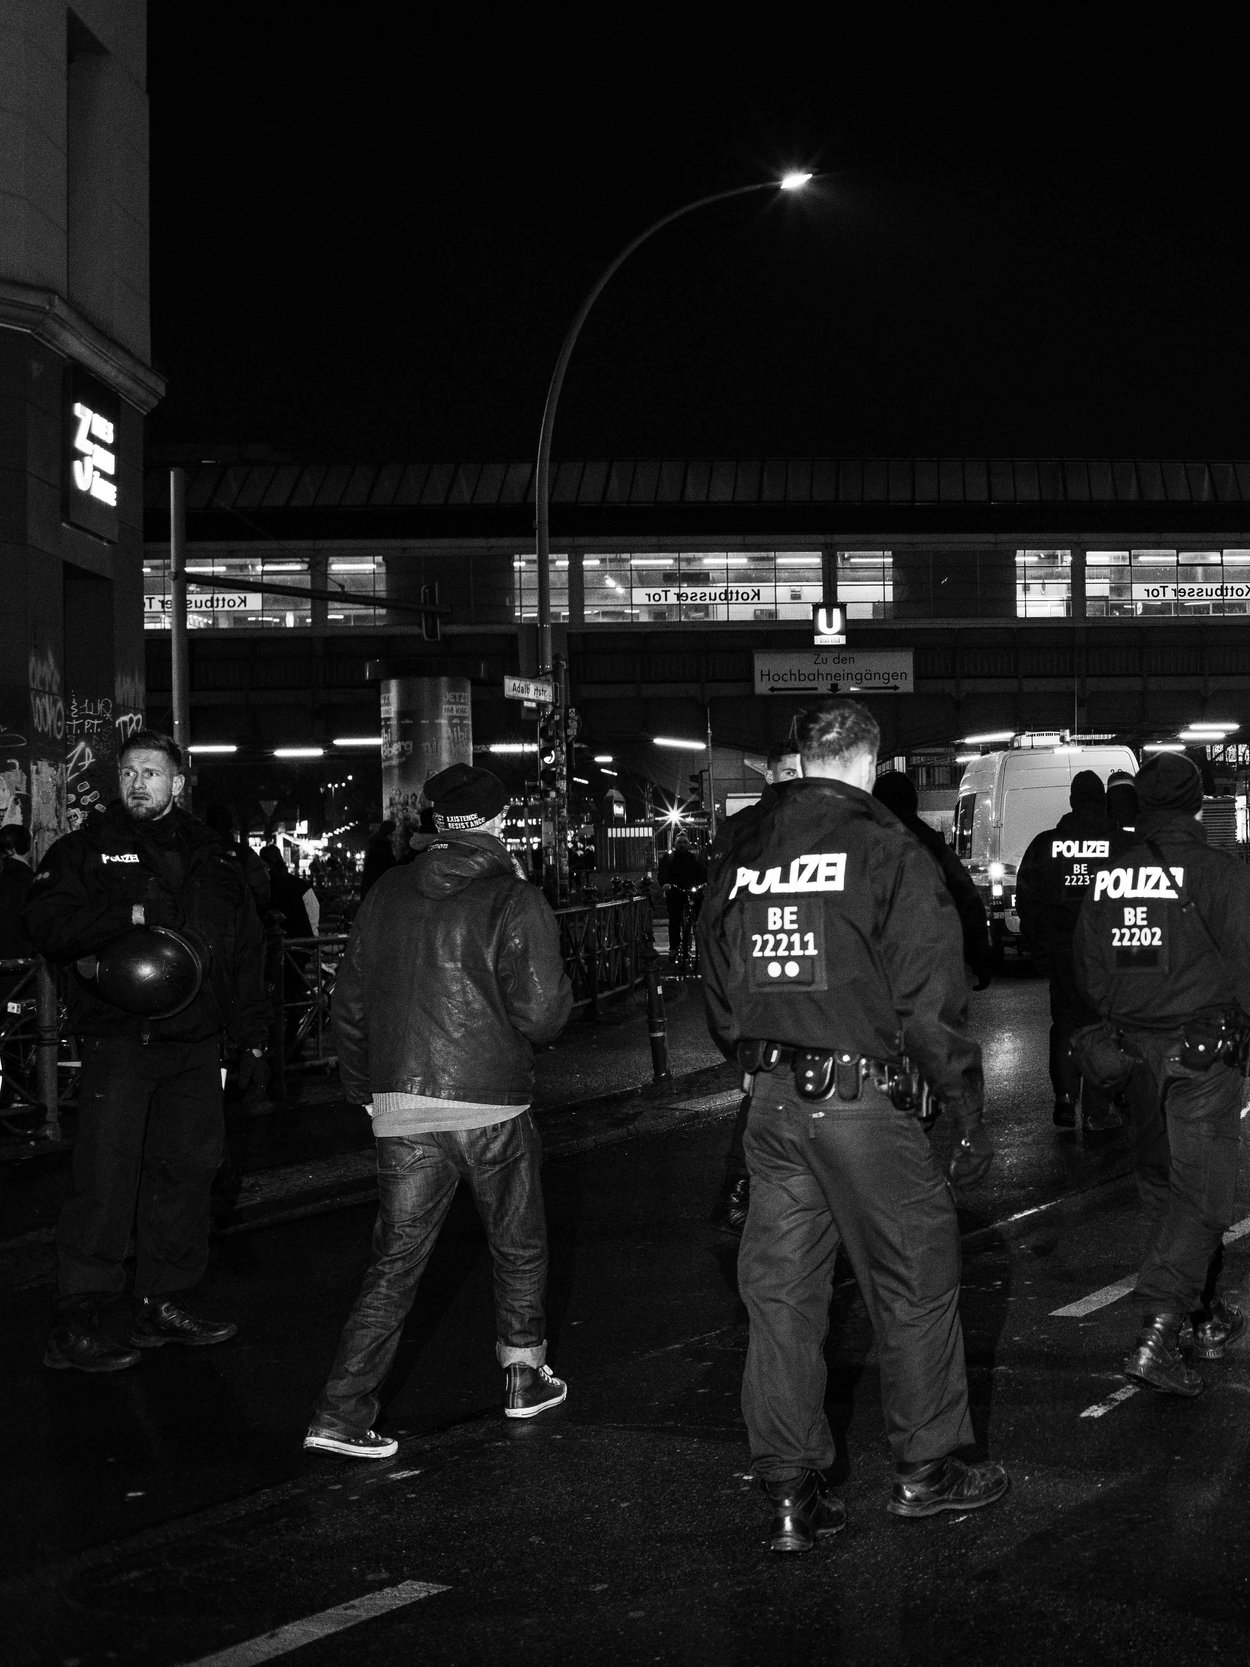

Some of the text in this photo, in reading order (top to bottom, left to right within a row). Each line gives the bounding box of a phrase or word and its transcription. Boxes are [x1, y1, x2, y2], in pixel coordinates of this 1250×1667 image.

[818, 607, 842, 635] U
[814, 653, 855, 665] Zu den
[760, 669, 908, 685] Hochbahneingängen
[1051, 840, 1110, 858] POLIZEI
[1073, 863, 1088, 875] BE
[1064, 874, 1095, 886] 2223
[767, 906, 799, 931] BE
[1123, 906, 1148, 926] BE
[751, 932, 819, 957] 22211
[1111, 927, 1163, 947] 22202
